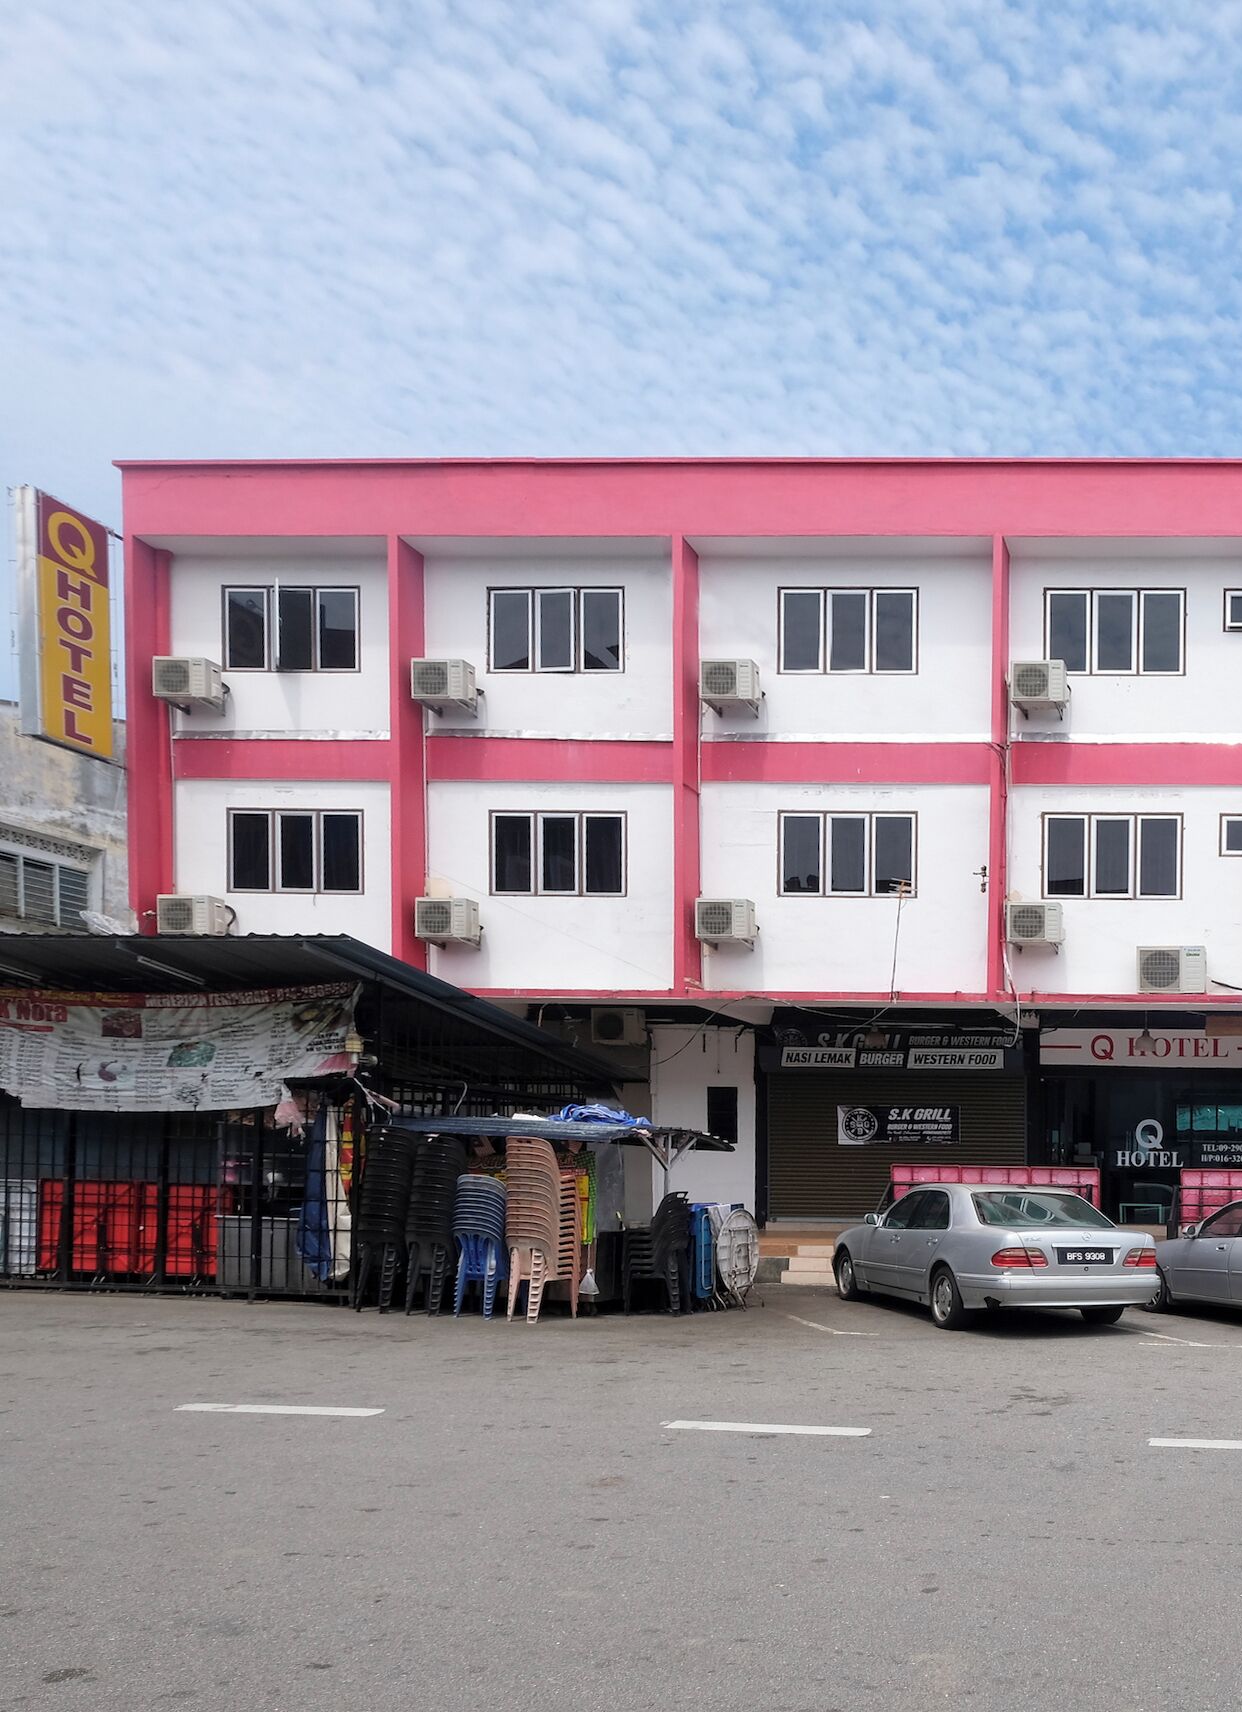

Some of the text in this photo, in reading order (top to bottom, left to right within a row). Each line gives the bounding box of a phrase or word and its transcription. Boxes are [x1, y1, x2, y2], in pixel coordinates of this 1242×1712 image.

[48, 511, 97, 579] Q
[57, 570, 93, 745] HOTEL
[16, 999, 68, 1023] Nora
[909, 1035, 940, 1046] BURGER
[941, 1036, 949, 1046] &
[950, 1035, 991, 1046] WESTERN
[1091, 1034, 1229, 1060] Q HOTEL
[785, 1052, 852, 1064] NASI LEMAK
[860, 1053, 904, 1065] BURGER
[913, 1054, 997, 1065] WESTERN FOOD
[888, 1108, 951, 1120] S.K GRILL
[1135, 1118, 1164, 1150] Q
[1116, 1151, 1183, 1167] HOTEL
[1066, 1252, 1106, 1261] BFS 9308
